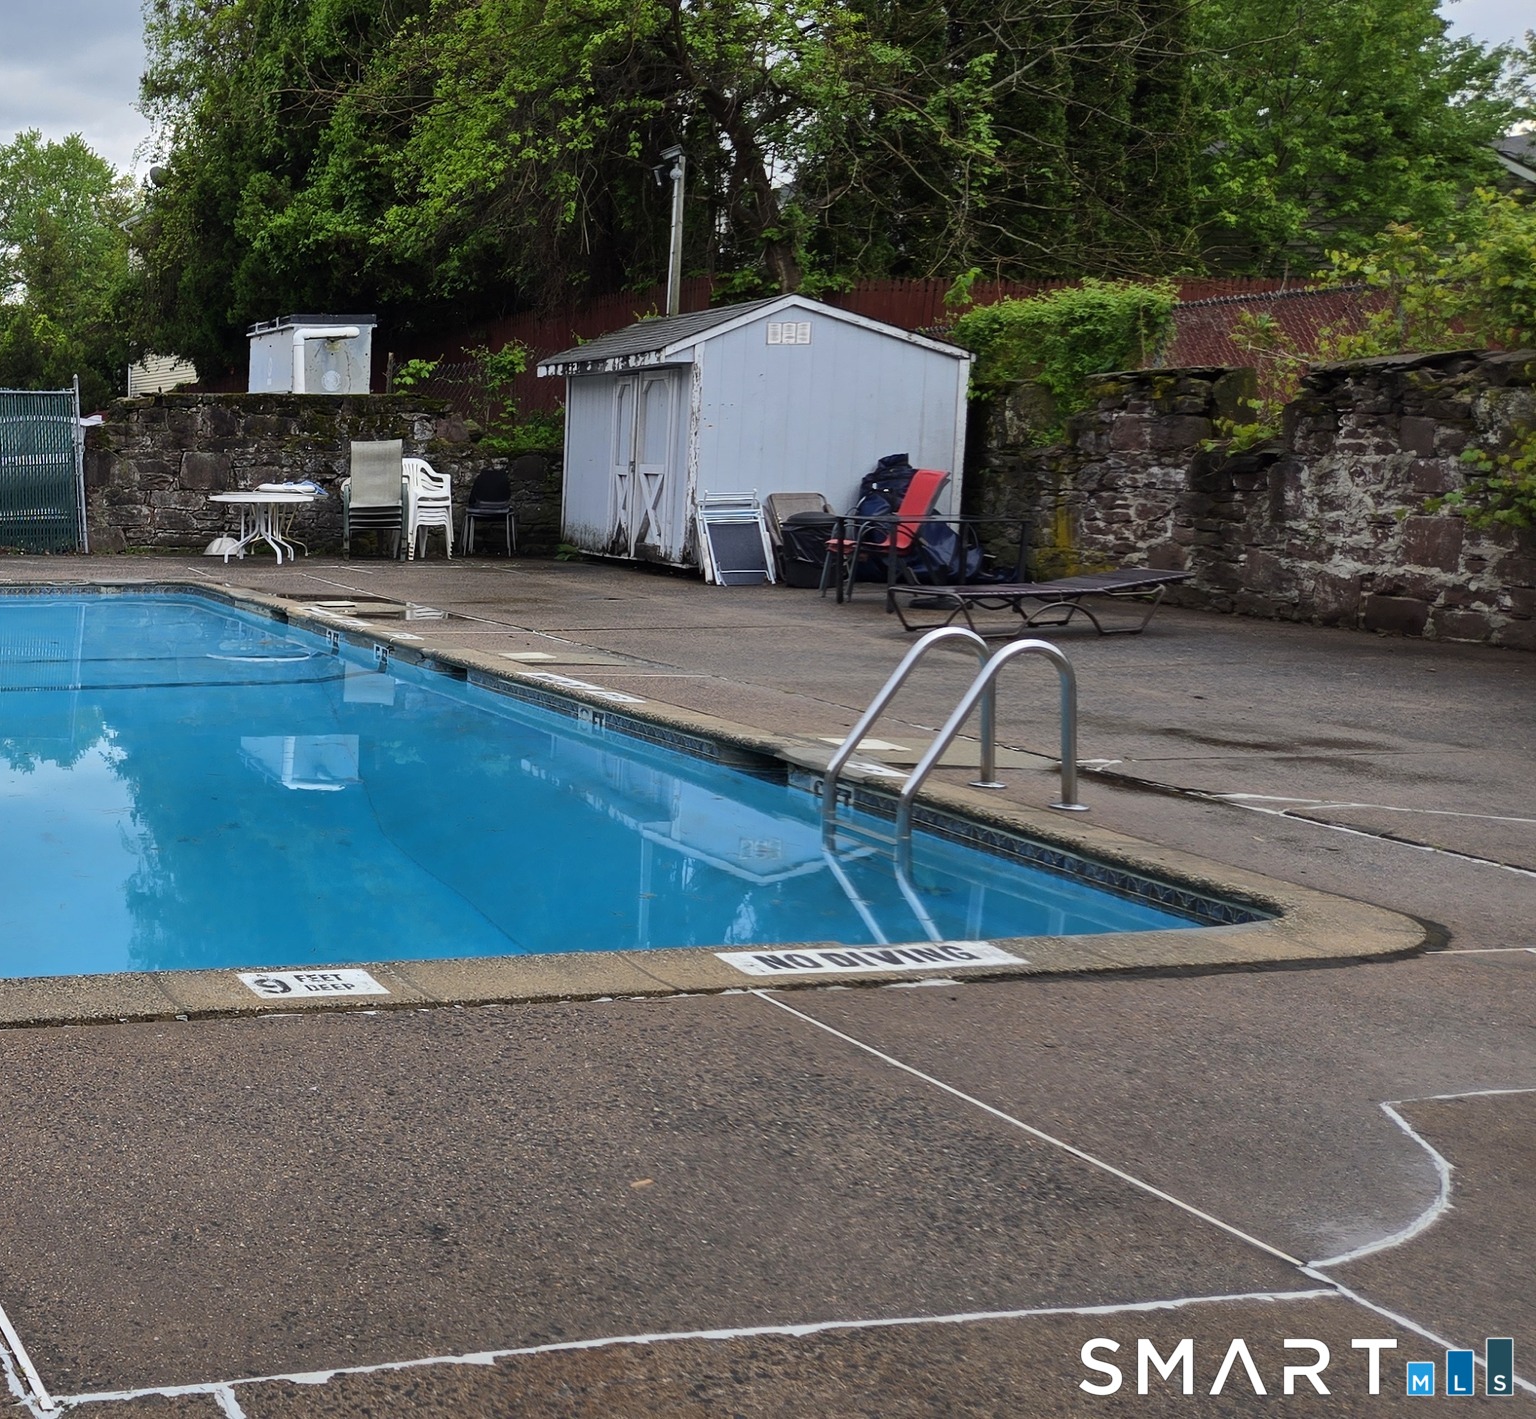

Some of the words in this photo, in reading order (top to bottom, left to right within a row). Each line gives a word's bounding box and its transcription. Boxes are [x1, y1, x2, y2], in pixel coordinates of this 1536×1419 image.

[752, 954, 823, 970] NO
[817, 945, 982, 968] DIVING
[254, 978, 292, 994] 9
[293, 973, 343, 983] FEET
[305, 983, 356, 992] DEEP
